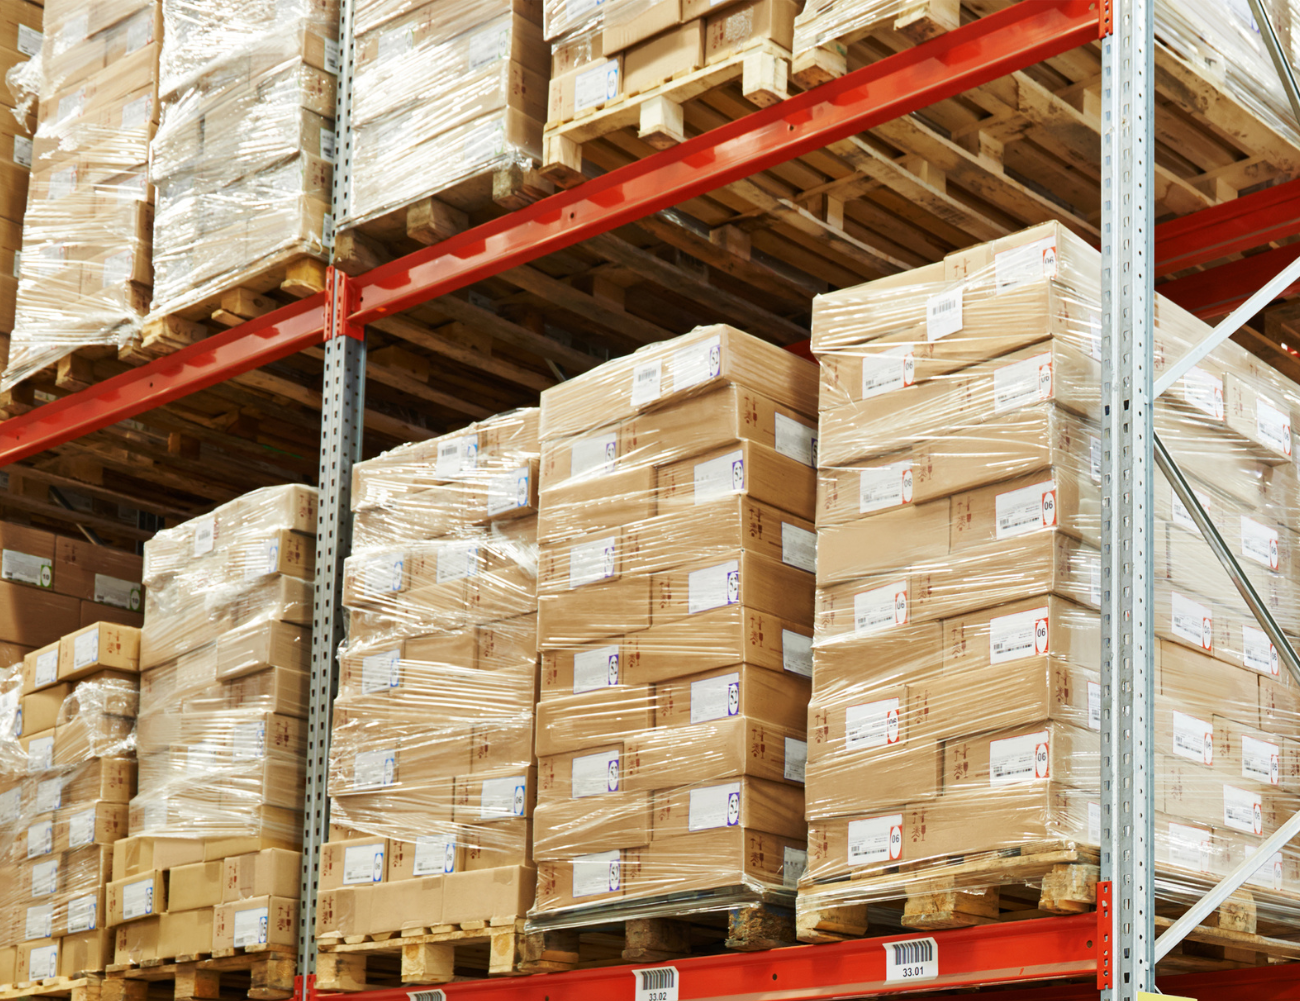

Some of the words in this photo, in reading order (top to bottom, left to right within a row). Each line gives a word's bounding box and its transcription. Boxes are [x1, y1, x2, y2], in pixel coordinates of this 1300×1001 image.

[905, 362, 914, 371] 06
[1044, 501, 1053, 511] 06
[1036, 629, 1046, 638] 06
[730, 689, 738, 706] 52
[1037, 752, 1046, 762] 06
[730, 797, 738, 815] 52
[891, 834, 900, 844] 06
[902, 965, 924, 978] 33.01
[648, 991, 667, 1001] 33.02
